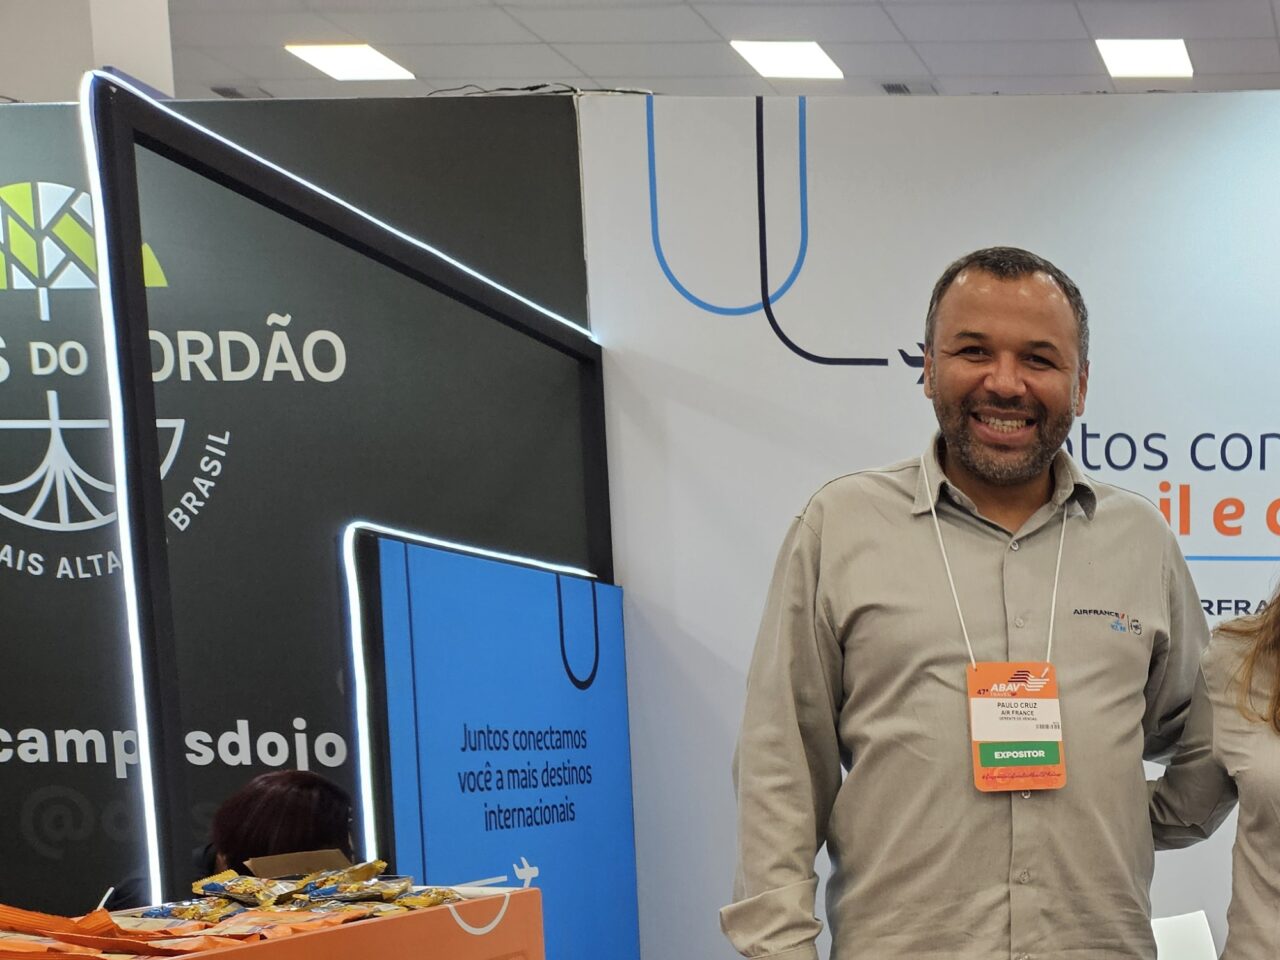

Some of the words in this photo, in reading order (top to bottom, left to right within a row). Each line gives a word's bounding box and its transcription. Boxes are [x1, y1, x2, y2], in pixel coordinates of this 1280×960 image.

[29, 340, 89, 376] DO
[148, 313, 347, 383] ORDÃO
[0, 544, 45, 577] AIS
[167, 431, 231, 532] BRASIL
[1212, 497, 1246, 537] e
[1073, 608, 1120, 619] AIRFRANCE
[990, 683, 1020, 693] ABAV
[461, 723, 509, 752] Juntos
[512, 725, 587, 751] conectamos
[994, 750, 1046, 759] EXPOSITOR
[457, 761, 492, 793] você
[495, 769, 504, 790] a
[507, 761, 539, 790] mais
[541, 759, 592, 788] destinos
[484, 795, 576, 831] internacionais
